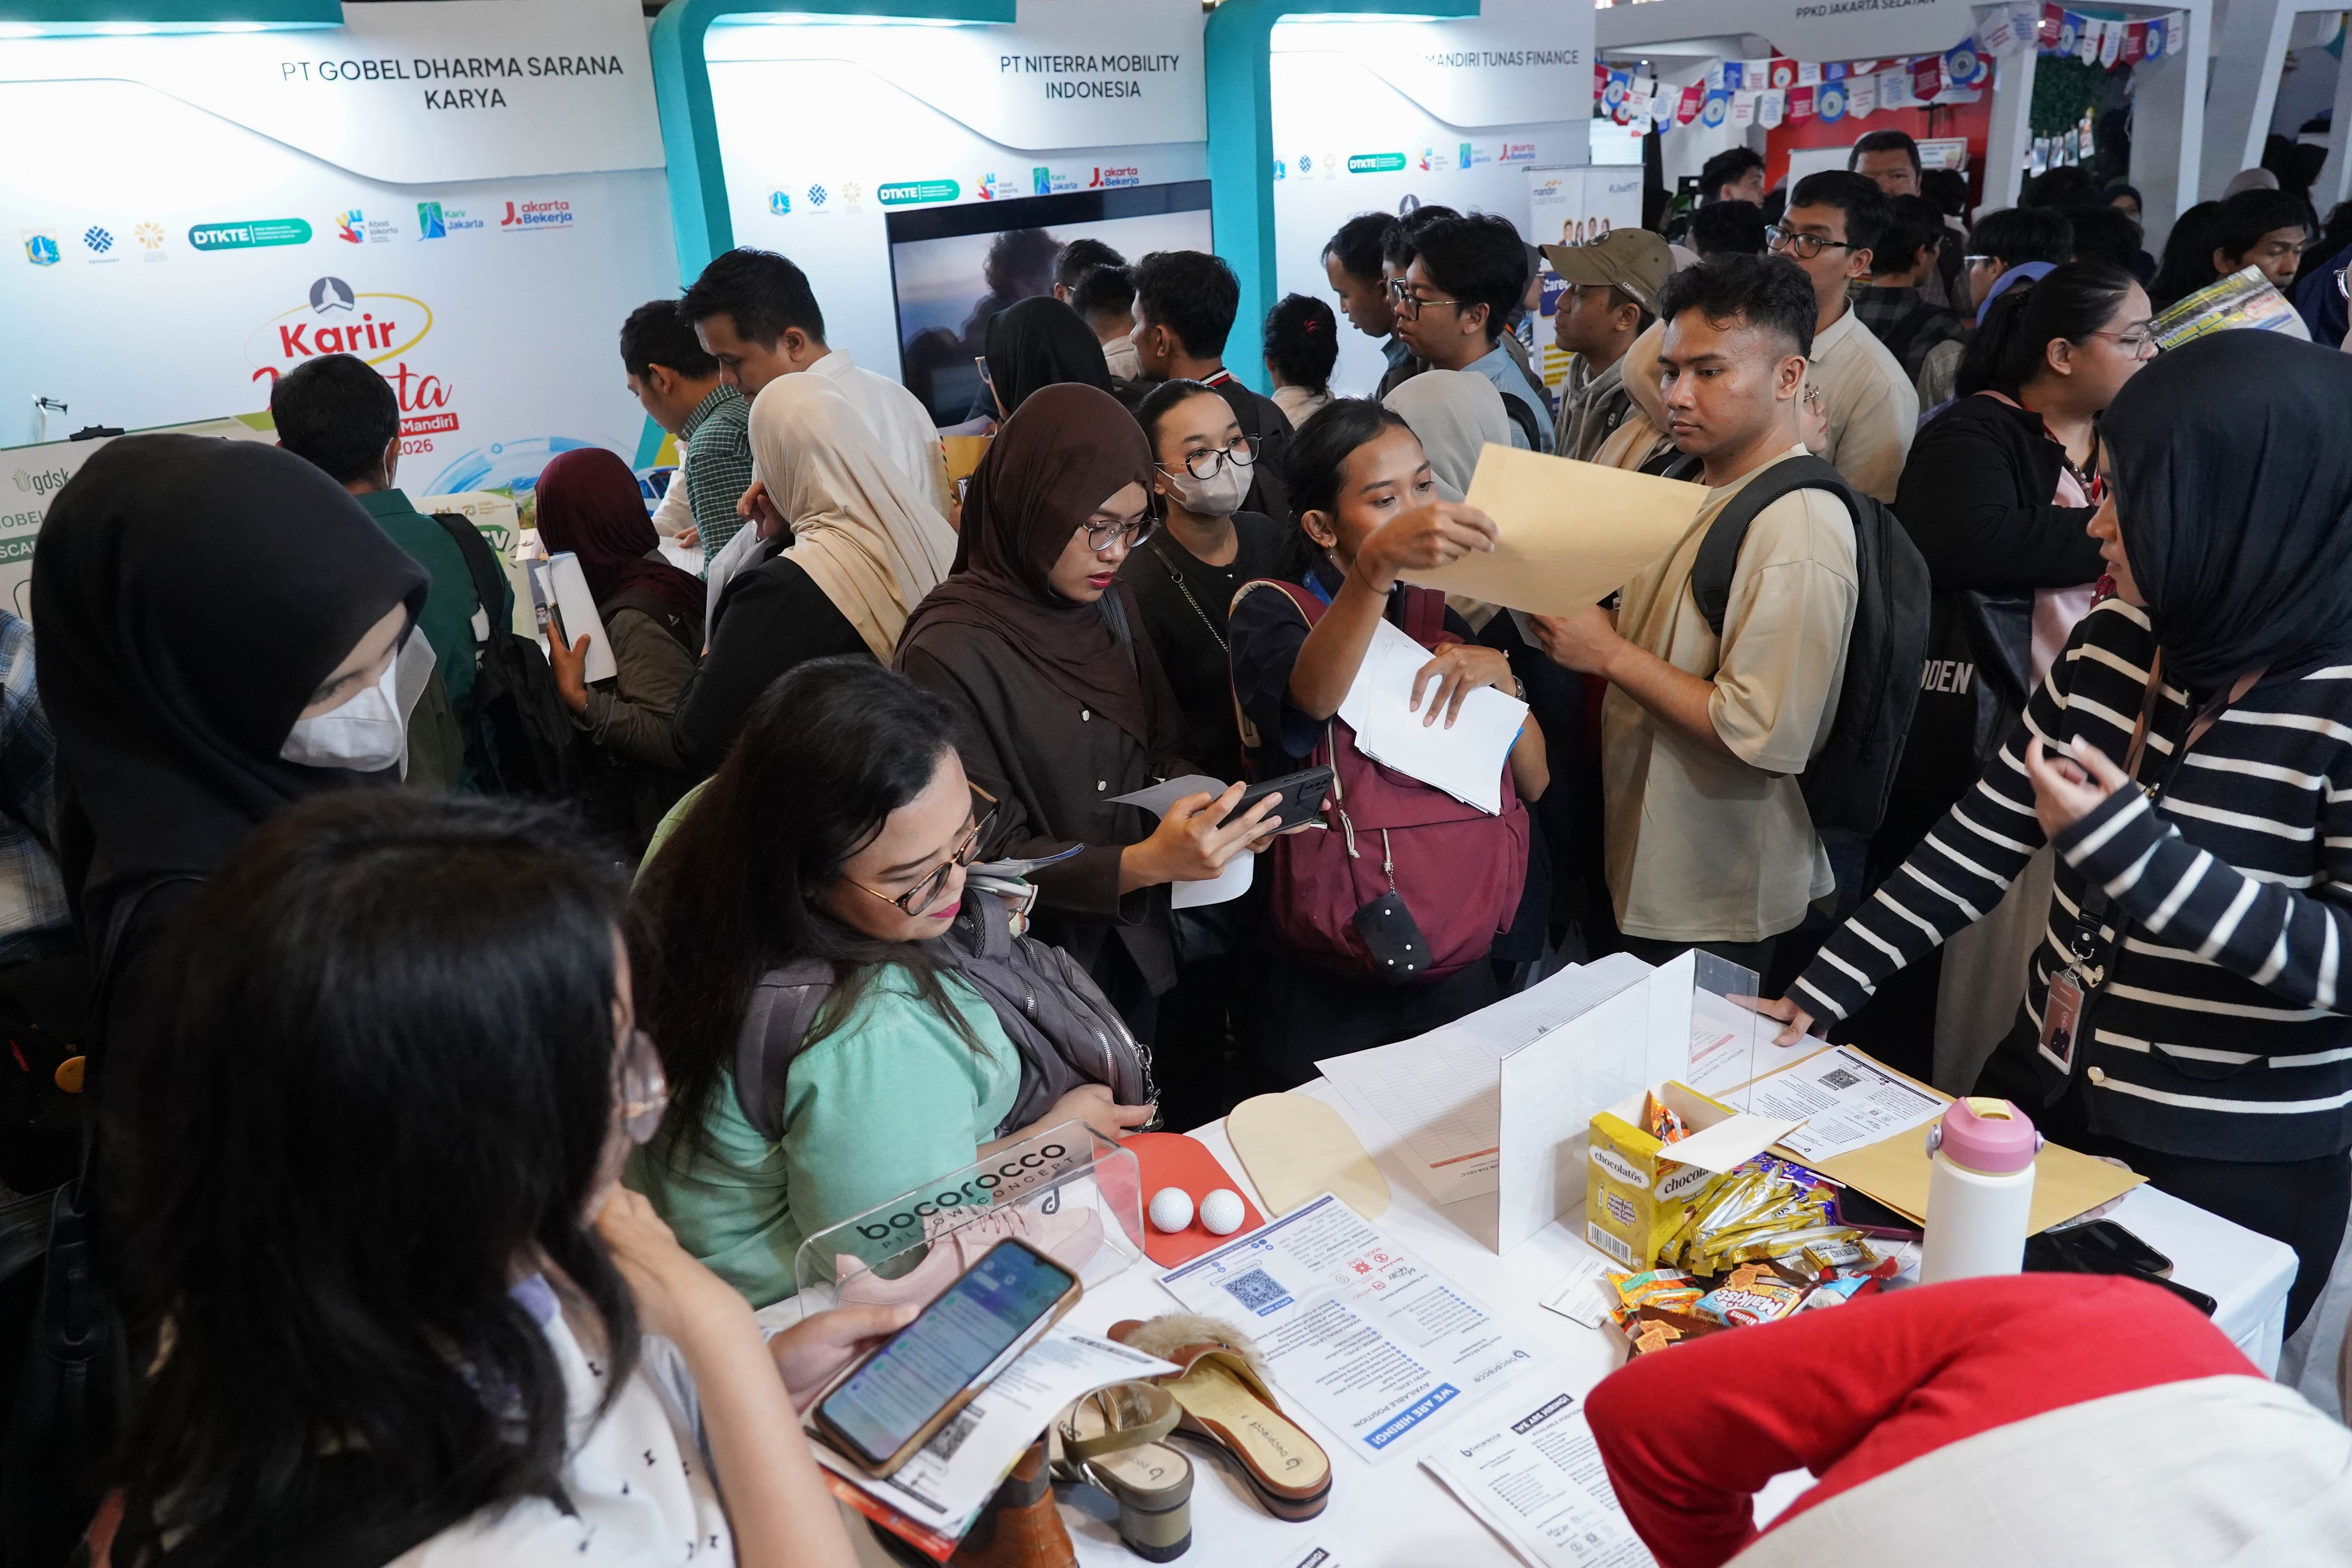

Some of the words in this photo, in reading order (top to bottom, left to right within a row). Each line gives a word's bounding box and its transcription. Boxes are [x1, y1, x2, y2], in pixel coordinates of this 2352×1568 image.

[1001, 56, 1020, 72] PT
[1026, 55, 1097, 72] NITERRA
[1102, 55, 1179, 72] MOBILITY
[1483, 52, 1523, 66] TUNAS
[1526, 50, 1579, 65] FINANCE
[282, 62, 310, 81] PT
[319, 61, 410, 80] GOBEL
[415, 58, 523, 79] DHARMA
[527, 56, 623, 77] SARANA
[425, 89, 507, 109] KARYA
[1046, 81, 1141, 99] INDONESIA
[1052, 182, 1078, 190] Jakarta
[1105, 177, 1139, 187] Bekerja
[880, 186, 918, 200] DTKTE
[447, 219, 484, 230] Jakarta
[524, 212, 573, 223] Bekerja
[194, 228, 249, 245] DTKTE
[279, 313, 396, 357] Karir
[401, 415, 454, 433] Mandiri
[398, 439, 433, 456] 2026
[33, 468, 69, 495] gdsk
[0, 510, 42, 529] OBEL
[857, 1144, 1066, 1240] bocorocco
[881, 1207, 964, 1250] PILLOW
[977, 1157, 1075, 1205] CONCEPT
[1259, 1305, 1275, 1316] NOW
[1273, 1297, 1292, 1308] APPLY
[1714, 1288, 1786, 1316] Malkist
[1730, 1310, 1760, 1326] Roma
[1325, 1318, 1362, 1338] MANAGERIAL
[1361, 1334, 1383, 1347] SENIOR
[1411, 1370, 1431, 1382] ENTRY
[1473, 1356, 1518, 1383] bocorocco
[1388, 1382, 1431, 1407] AVAILABLE
[1431, 1387, 1454, 1402] WE
[1350, 1405, 1391, 1429] POSITION:
[1410, 1399, 1435, 1418] ARE
[1514, 1421, 1531, 1432] WE
[1527, 1412, 1544, 1425] ARE
[1540, 1395, 1570, 1416] HIRING!
[1370, 1413, 1415, 1445] HIRING!
[1532, 1420, 1559, 1436] AVAILABLE
